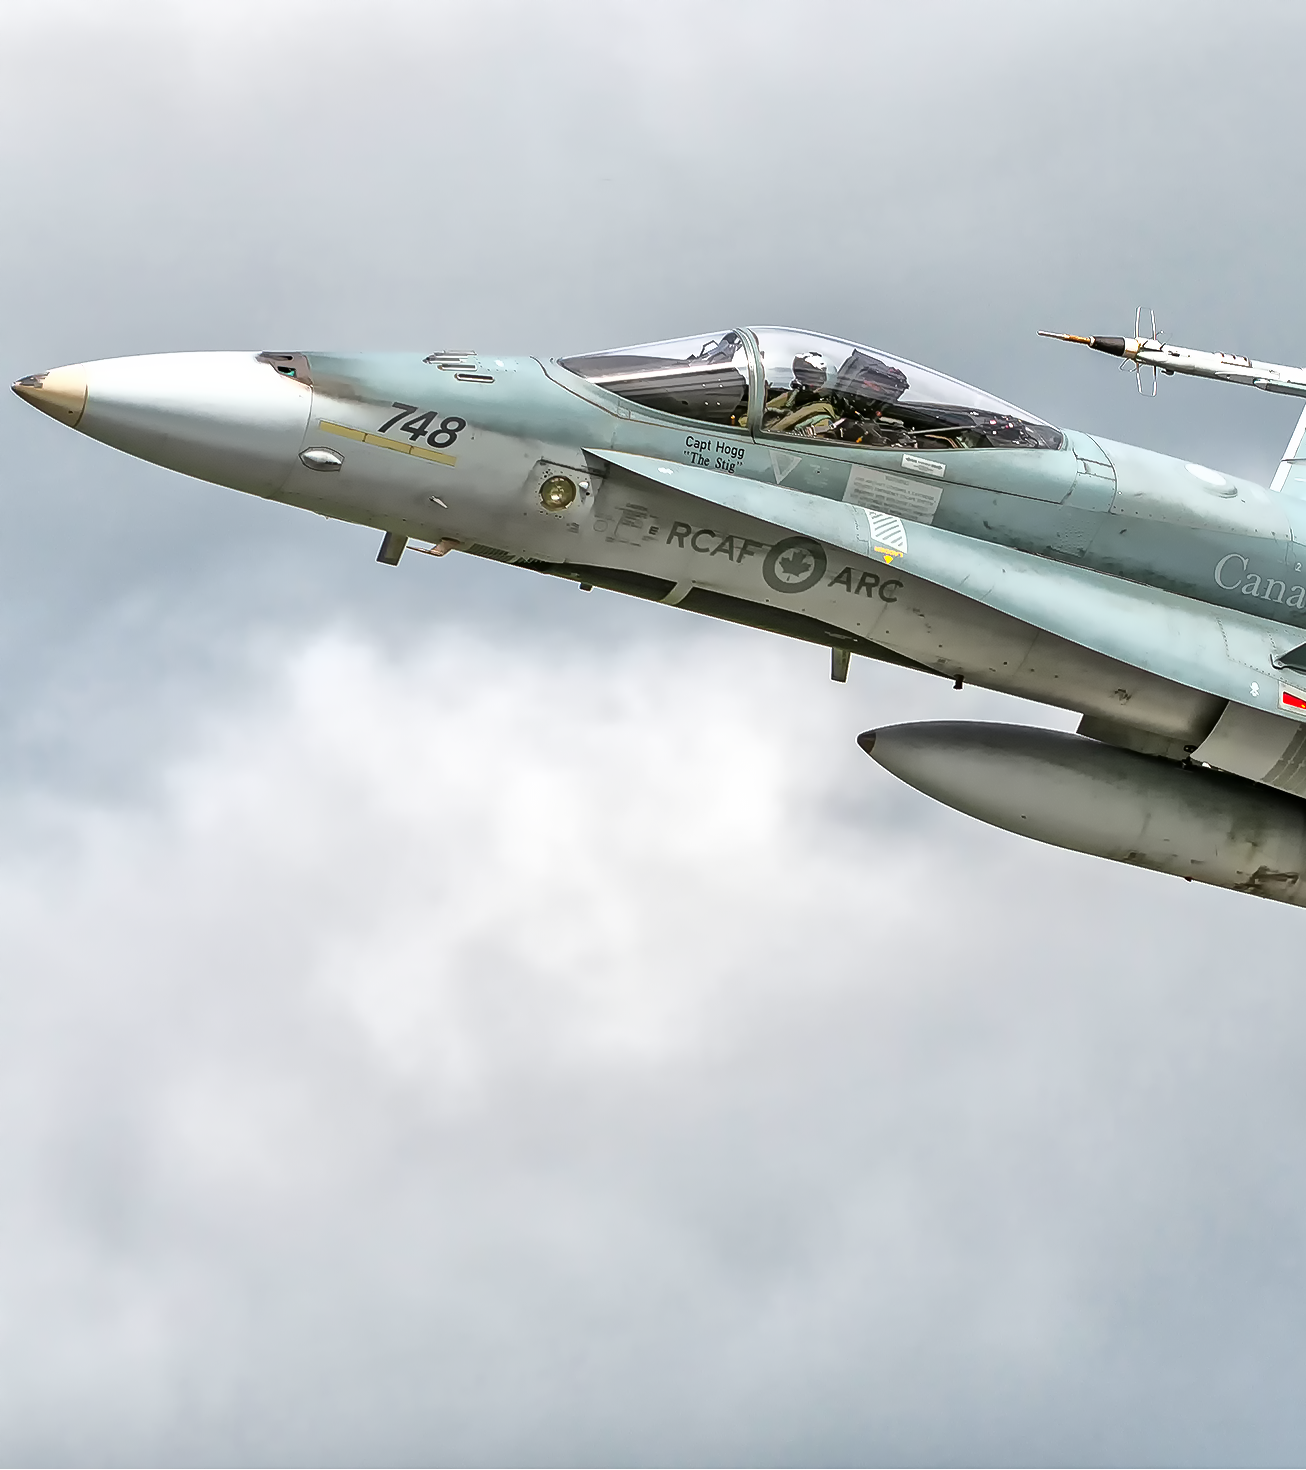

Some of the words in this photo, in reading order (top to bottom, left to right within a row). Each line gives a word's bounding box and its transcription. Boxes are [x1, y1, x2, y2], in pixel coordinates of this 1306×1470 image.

[377, 401, 467, 448] 748
[685, 435, 711, 452] Capt
[716, 441, 745, 459] Hogg
[666, 521, 763, 563] RCAF
[827, 566, 904, 603] ARC
[1295, 562, 1302, 572] 2
